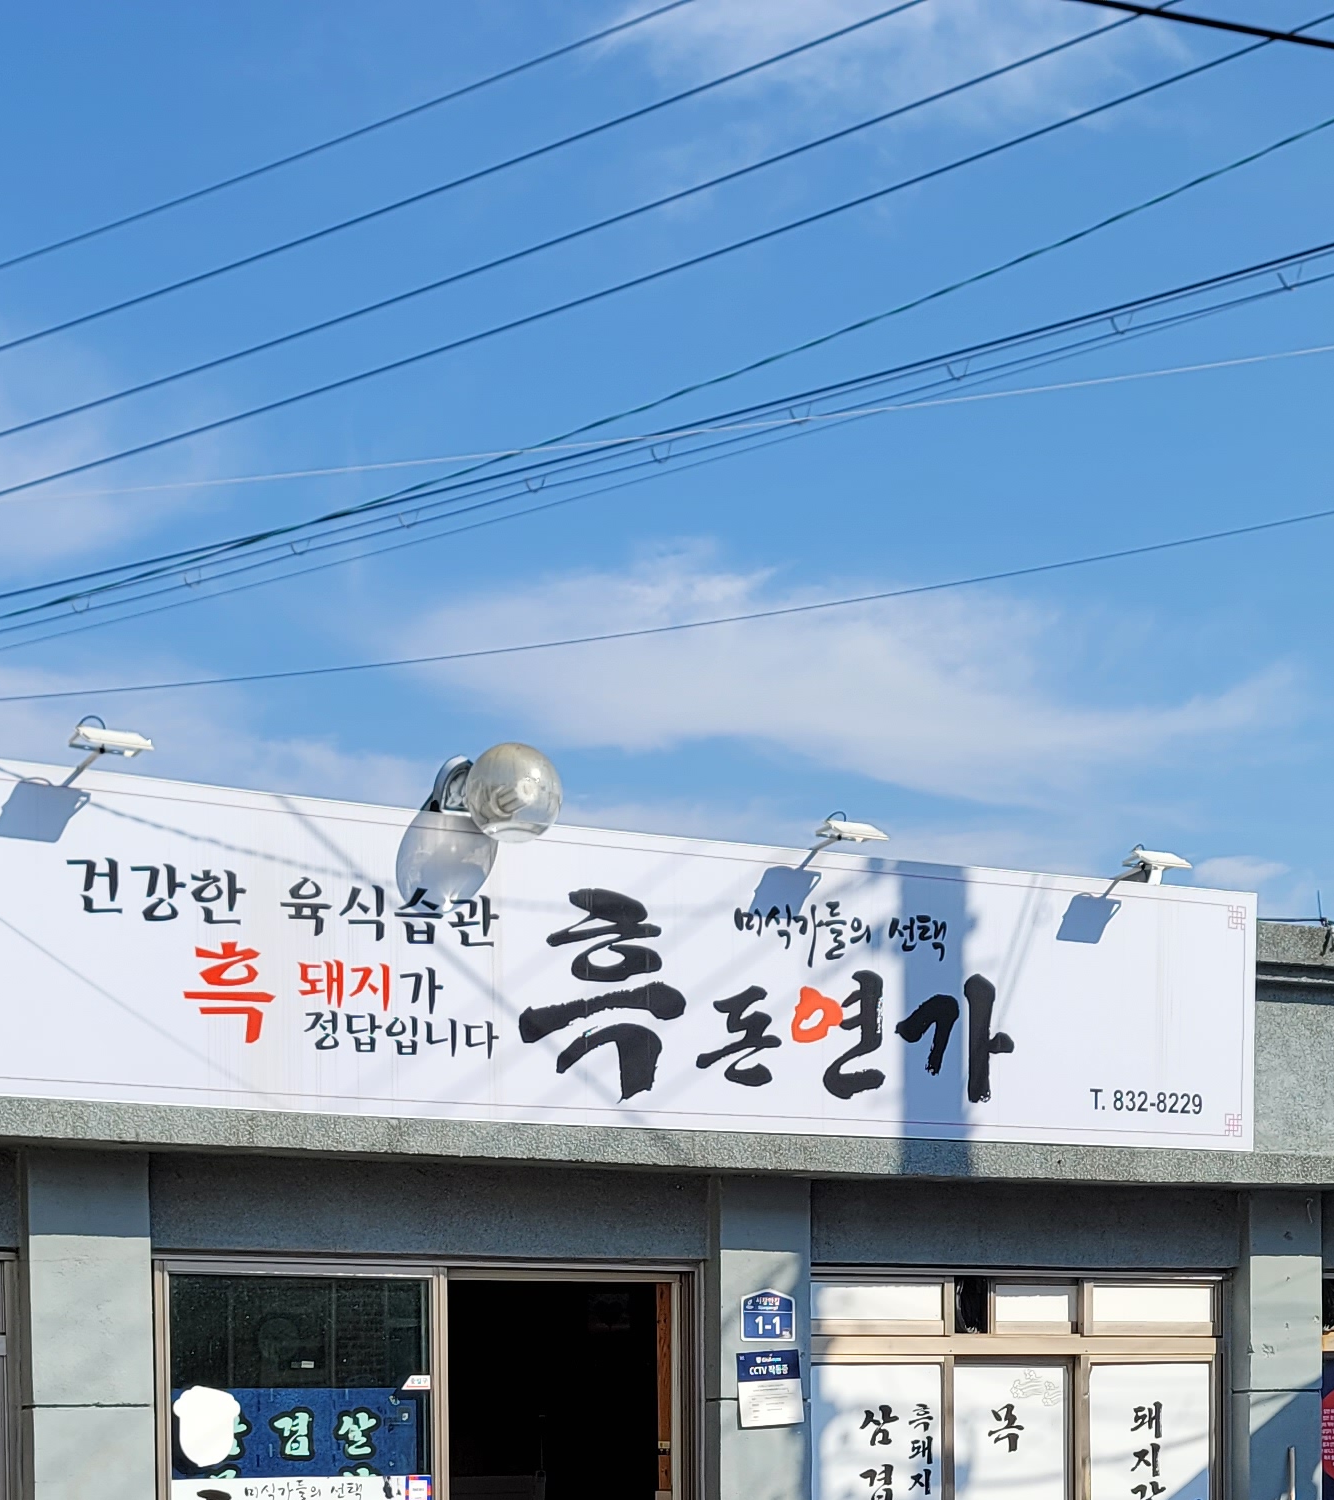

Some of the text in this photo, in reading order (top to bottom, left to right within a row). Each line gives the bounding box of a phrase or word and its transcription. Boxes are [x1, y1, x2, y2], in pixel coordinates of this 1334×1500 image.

[66, 857, 500, 948] 건강한 육식습관
[734, 901, 948, 967] 미식가들의 선택
[182, 941, 444, 1044] 흑 돼지가
[518, 888, 1015, 1104] 흑돈연가
[303, 1010, 500, 1059] 정답입니다
[1089, 1088, 1204, 1116] T. 832-8229
[754, 1315, 781, 1335] 1-1
[749, 1366, 767, 1376] CCTV
[908, 1403, 934, 1496] 흑돼지
